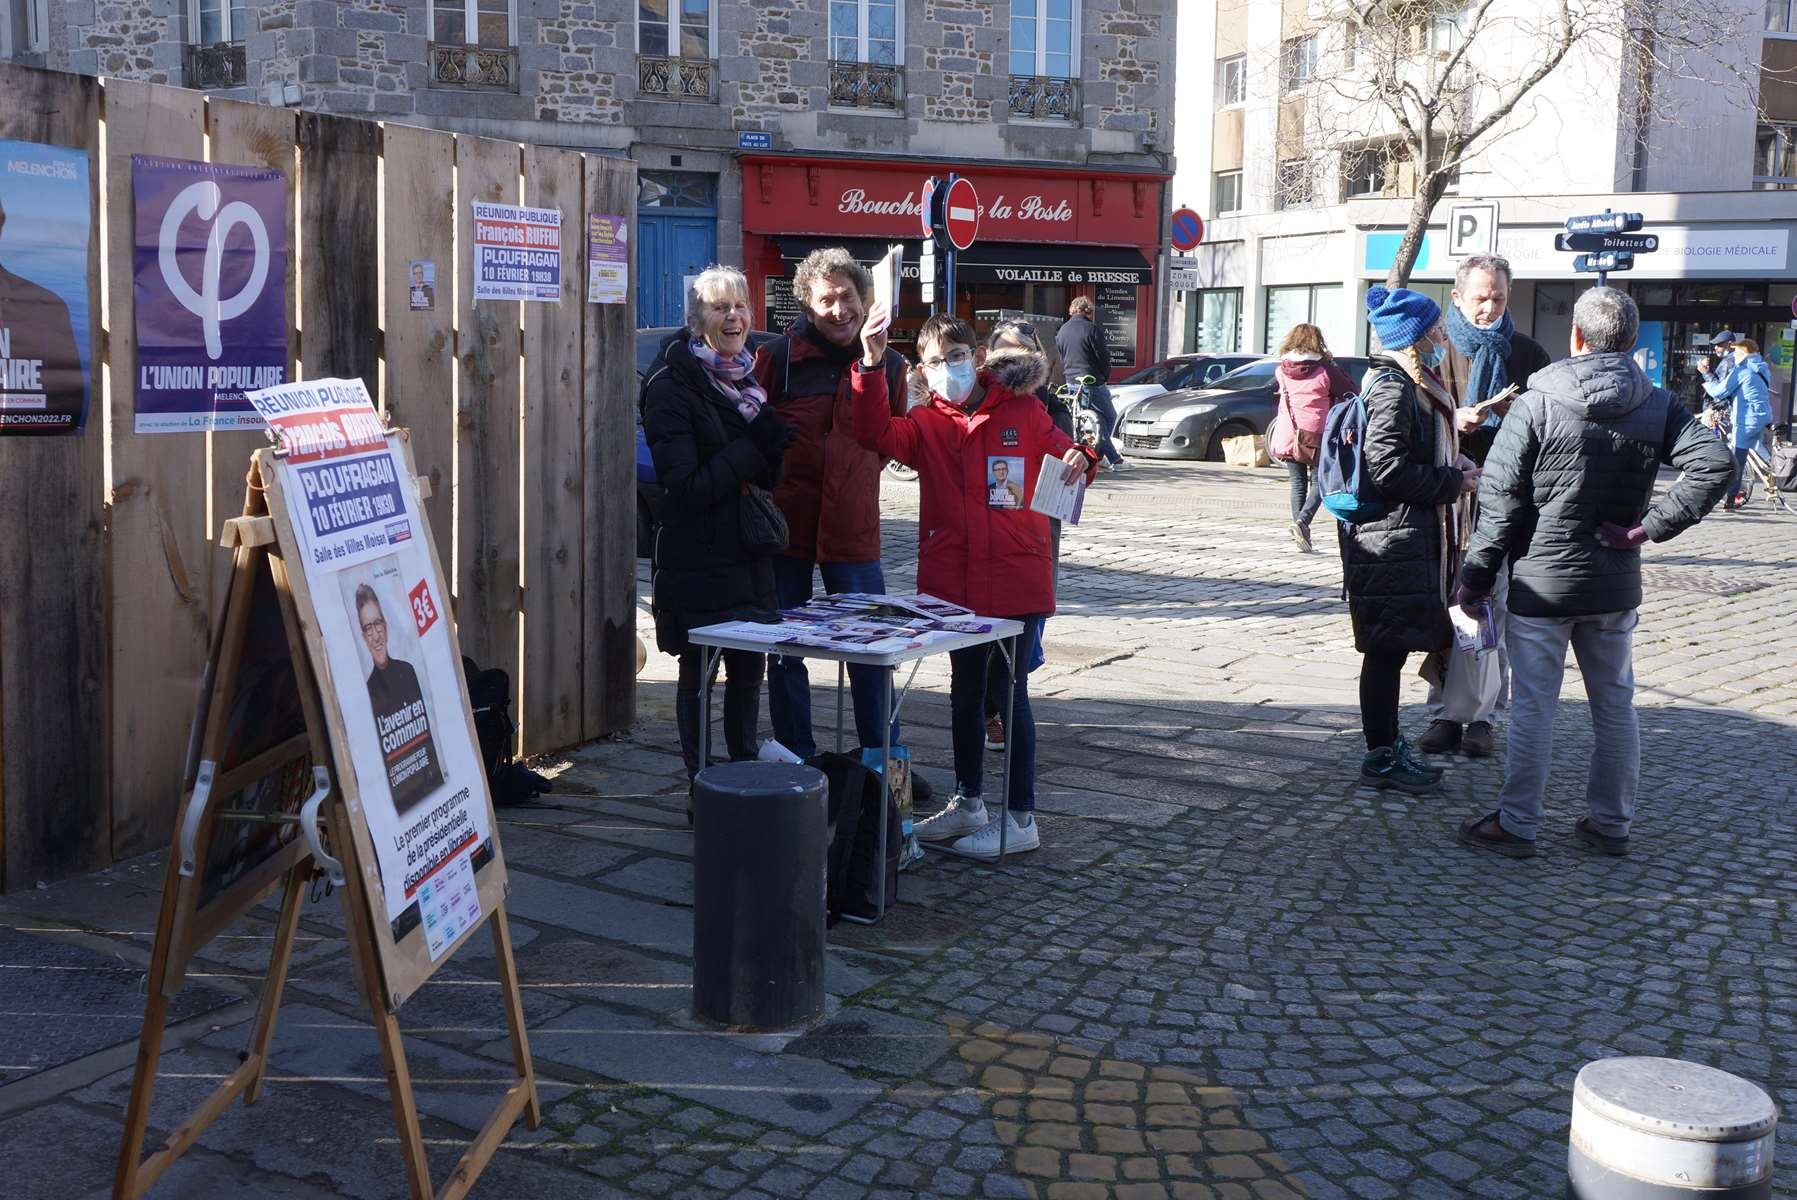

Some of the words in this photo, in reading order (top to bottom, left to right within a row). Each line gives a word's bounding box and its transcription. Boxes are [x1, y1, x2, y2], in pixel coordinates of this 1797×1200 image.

[476, 205, 517, 220] RÉUNION
[520, 211, 558, 224] PUBLIQUE
[838, 188, 922, 216] Bouche
[989, 195, 1012, 219] la
[1017, 195, 1073, 221] Poste
[477, 222, 525, 246] François
[526, 226, 559, 246] RUFFIN
[1457, 214, 1478, 247] P
[1603, 238, 1644, 247] Toilettes
[484, 249, 558, 267] PLOUFRAGAN
[1674, 247, 1721, 256] BIOLOGIE
[1725, 244, 1777, 256] MÉDICALE
[483, 266, 495, 280] 10
[498, 265, 530, 281] FÉVRIER
[531, 271, 552, 283] 19H30
[900, 266, 921, 278] MO
[995, 269, 1062, 282] VOLAILLE
[1068, 271, 1083, 282] de
[1087, 271, 1139, 284] BRESSE
[477, 285, 490, 294] Salle
[492, 286, 501, 294] des
[517, 287, 534, 296] Mosan
[141, 366, 203, 389] L'UNION
[207, 366, 284, 389] POPULAIRE
[214, 392, 250, 401] MELENCH
[255, 388, 320, 416] RÉUNION
[318, 385, 368, 407] PUBLIQUE
[188, 416, 200, 426] La
[203, 416, 235, 426] France
[340, 411, 385, 446] RUFFIN
[301, 458, 395, 500] PLOUFRAGAN
[312, 505, 330, 532] 10
[327, 497, 375, 528] FÉVRIER
[372, 493, 396, 517] 19H30
[314, 544, 333, 564] Salle
[333, 541, 346, 558] des
[344, 537, 365, 555] Villes
[364, 532, 388, 550] Moisan
[413, 588, 434, 628] 3€
[377, 701, 413, 737] L'avenir
[412, 699, 425, 717] en
[382, 715, 428, 754] commun
[393, 834, 405, 852] Le
[404, 814, 431, 849] premier
[431, 786, 470, 828] programme
[406, 849, 417, 867] de
[416, 842, 424, 860] la
[423, 809, 468, 861] présidentielle
[403, 852, 439, 891] disponible
[439, 847, 449, 862] en
[448, 826, 473, 857] librairie
